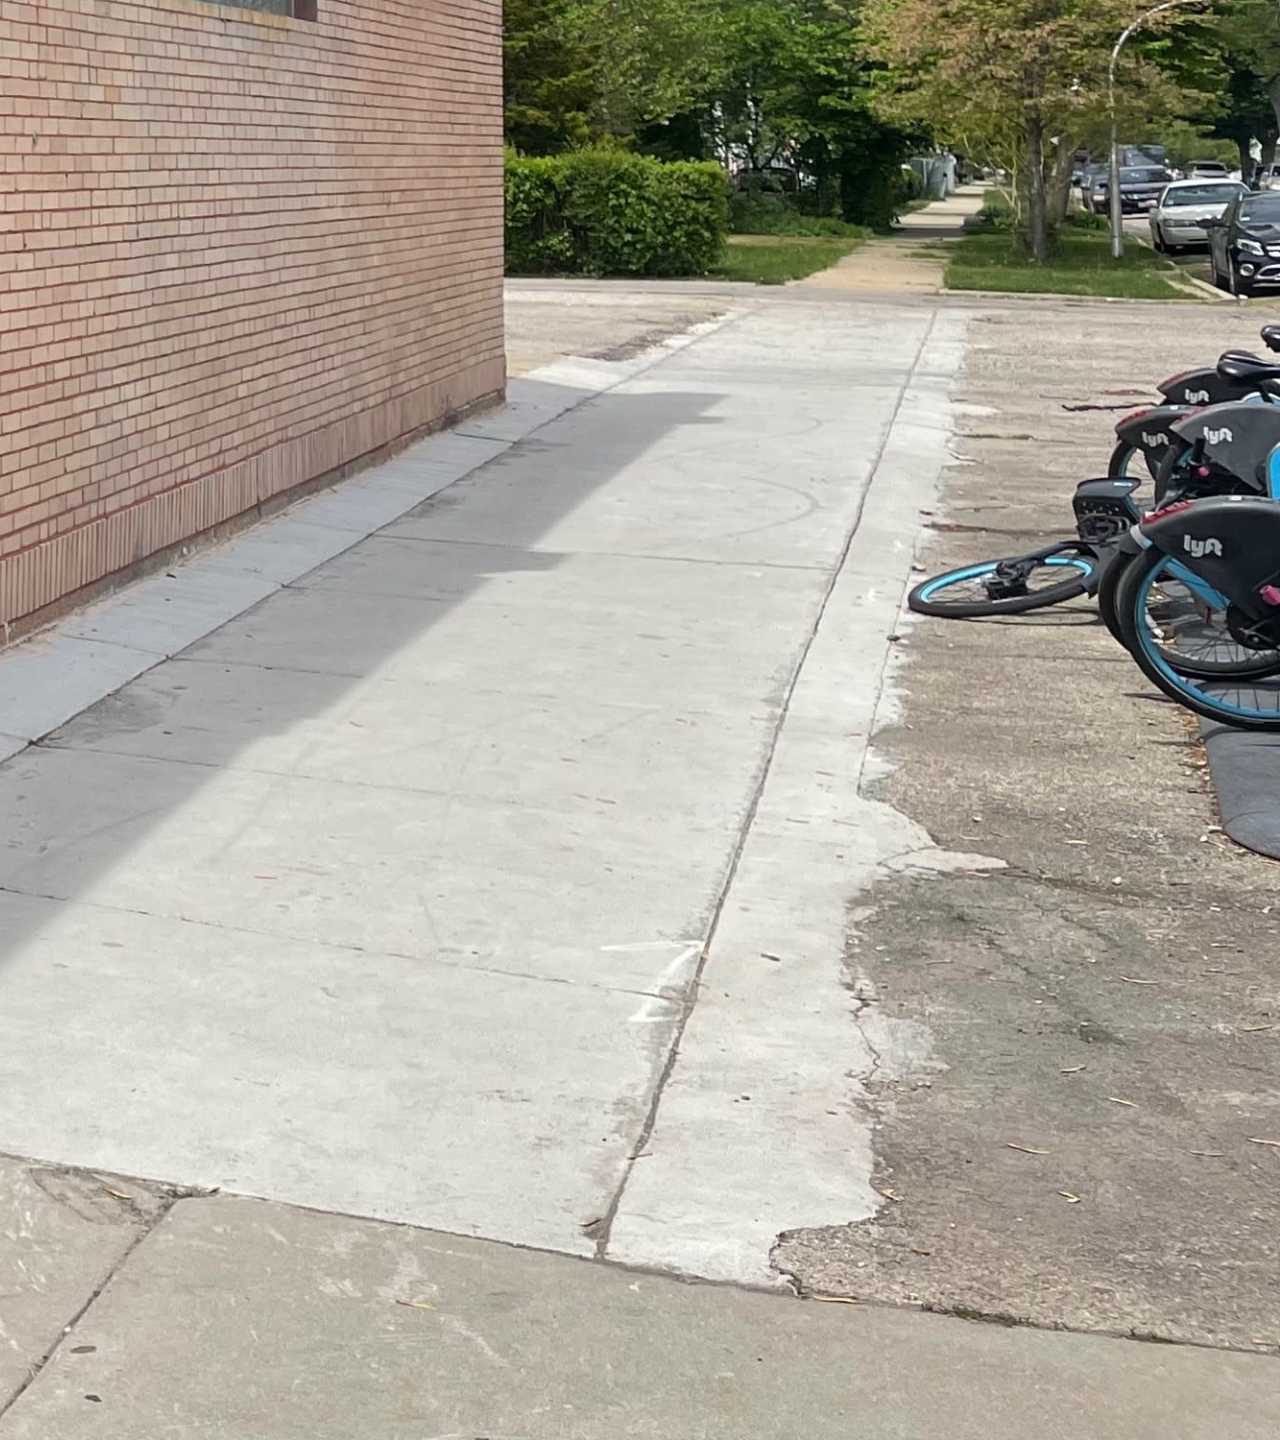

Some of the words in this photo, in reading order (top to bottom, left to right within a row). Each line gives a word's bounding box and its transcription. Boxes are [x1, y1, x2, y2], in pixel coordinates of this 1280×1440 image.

[1184, 388, 1210, 404] lyft
[1142, 431, 1169, 447] lyft
[1203, 426, 1232, 444] lyft
[1183, 534, 1223, 557] lyft
